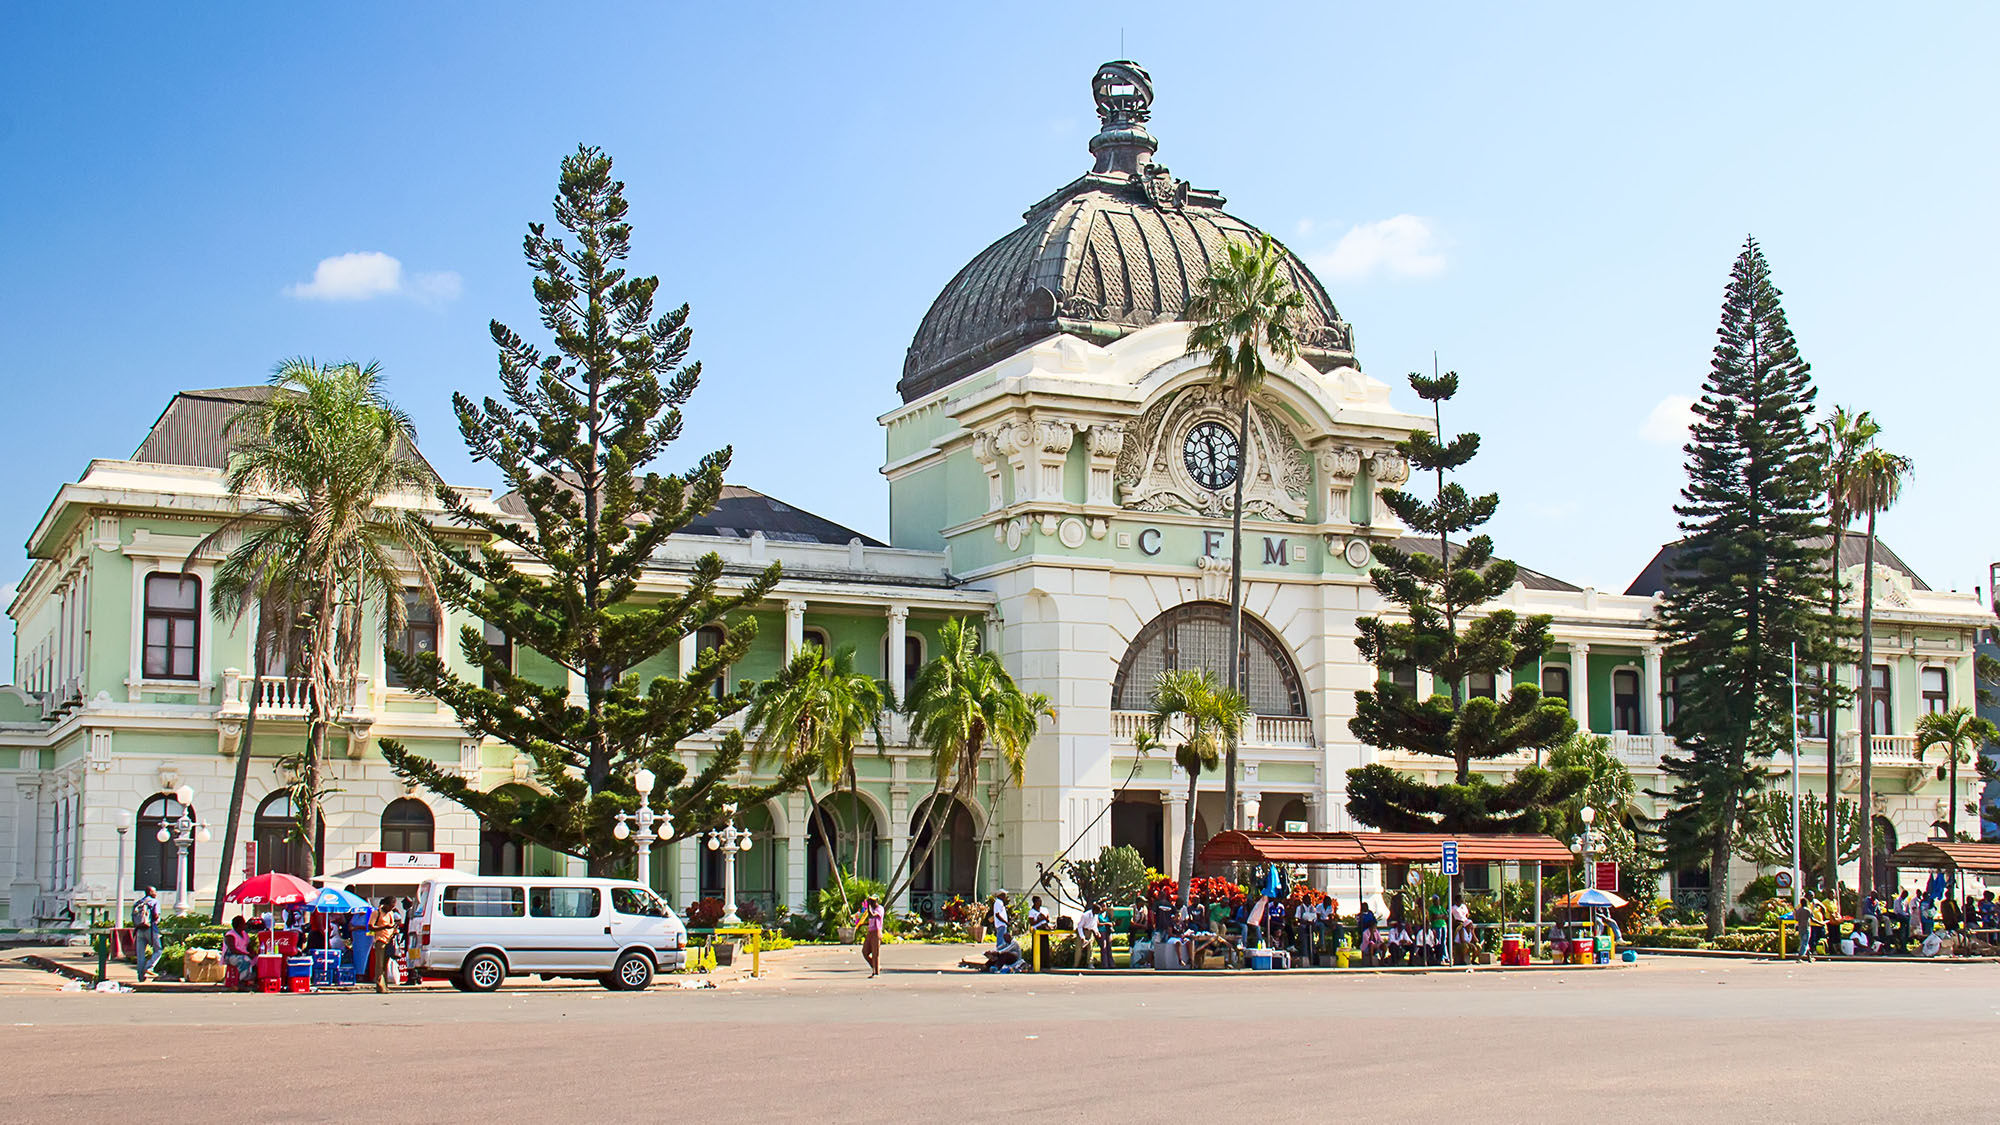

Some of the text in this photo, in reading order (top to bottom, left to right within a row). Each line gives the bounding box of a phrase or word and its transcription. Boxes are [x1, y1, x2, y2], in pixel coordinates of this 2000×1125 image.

[1138, 528, 1289, 566] C F M
